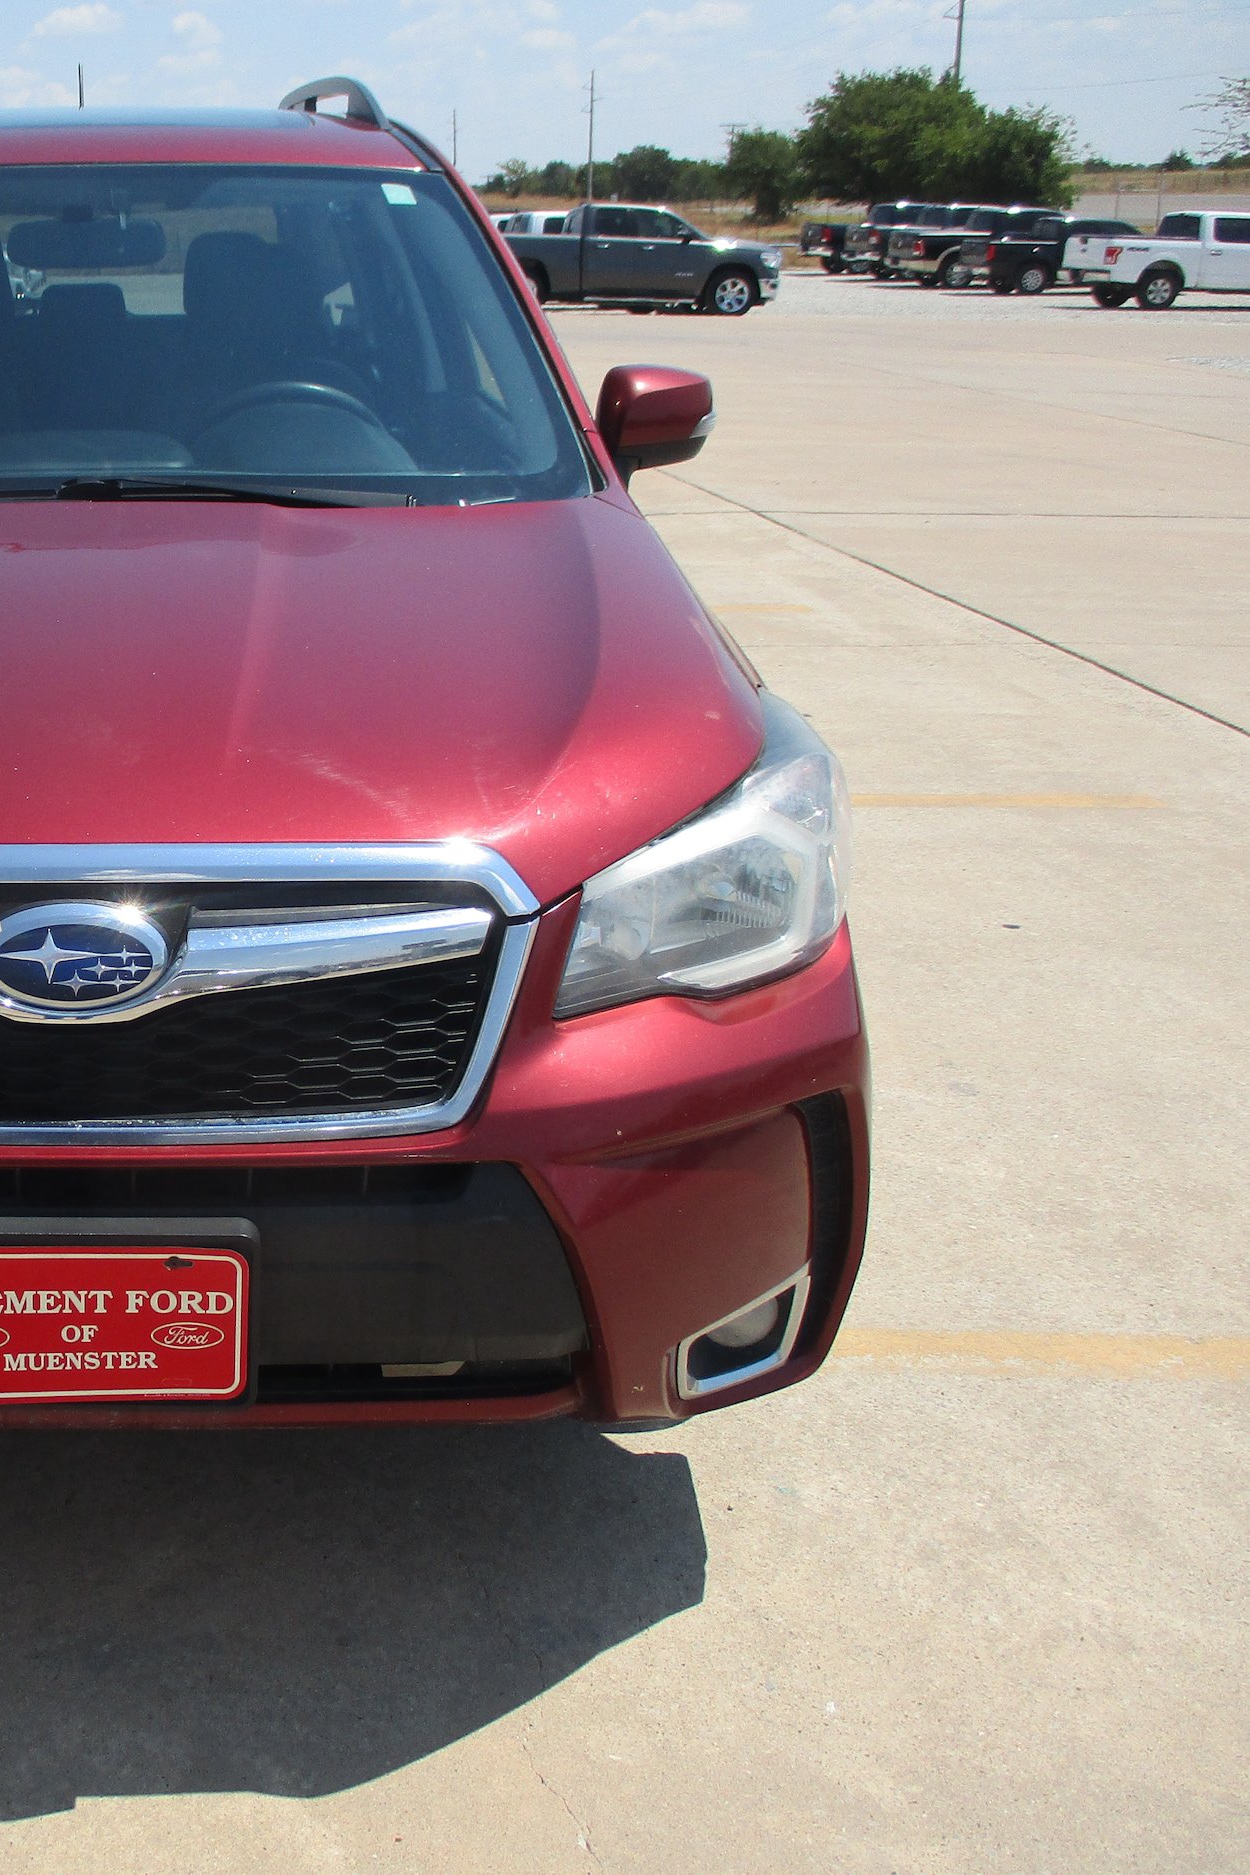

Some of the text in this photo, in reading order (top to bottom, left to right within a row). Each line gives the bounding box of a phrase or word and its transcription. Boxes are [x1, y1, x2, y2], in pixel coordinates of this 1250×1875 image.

[125, 1290, 234, 1315] FORD
[61, 1325, 99, 1343] OF
[163, 1325, 208, 1345] Ford
[3, 1351, 158, 1371] MUENSTER
